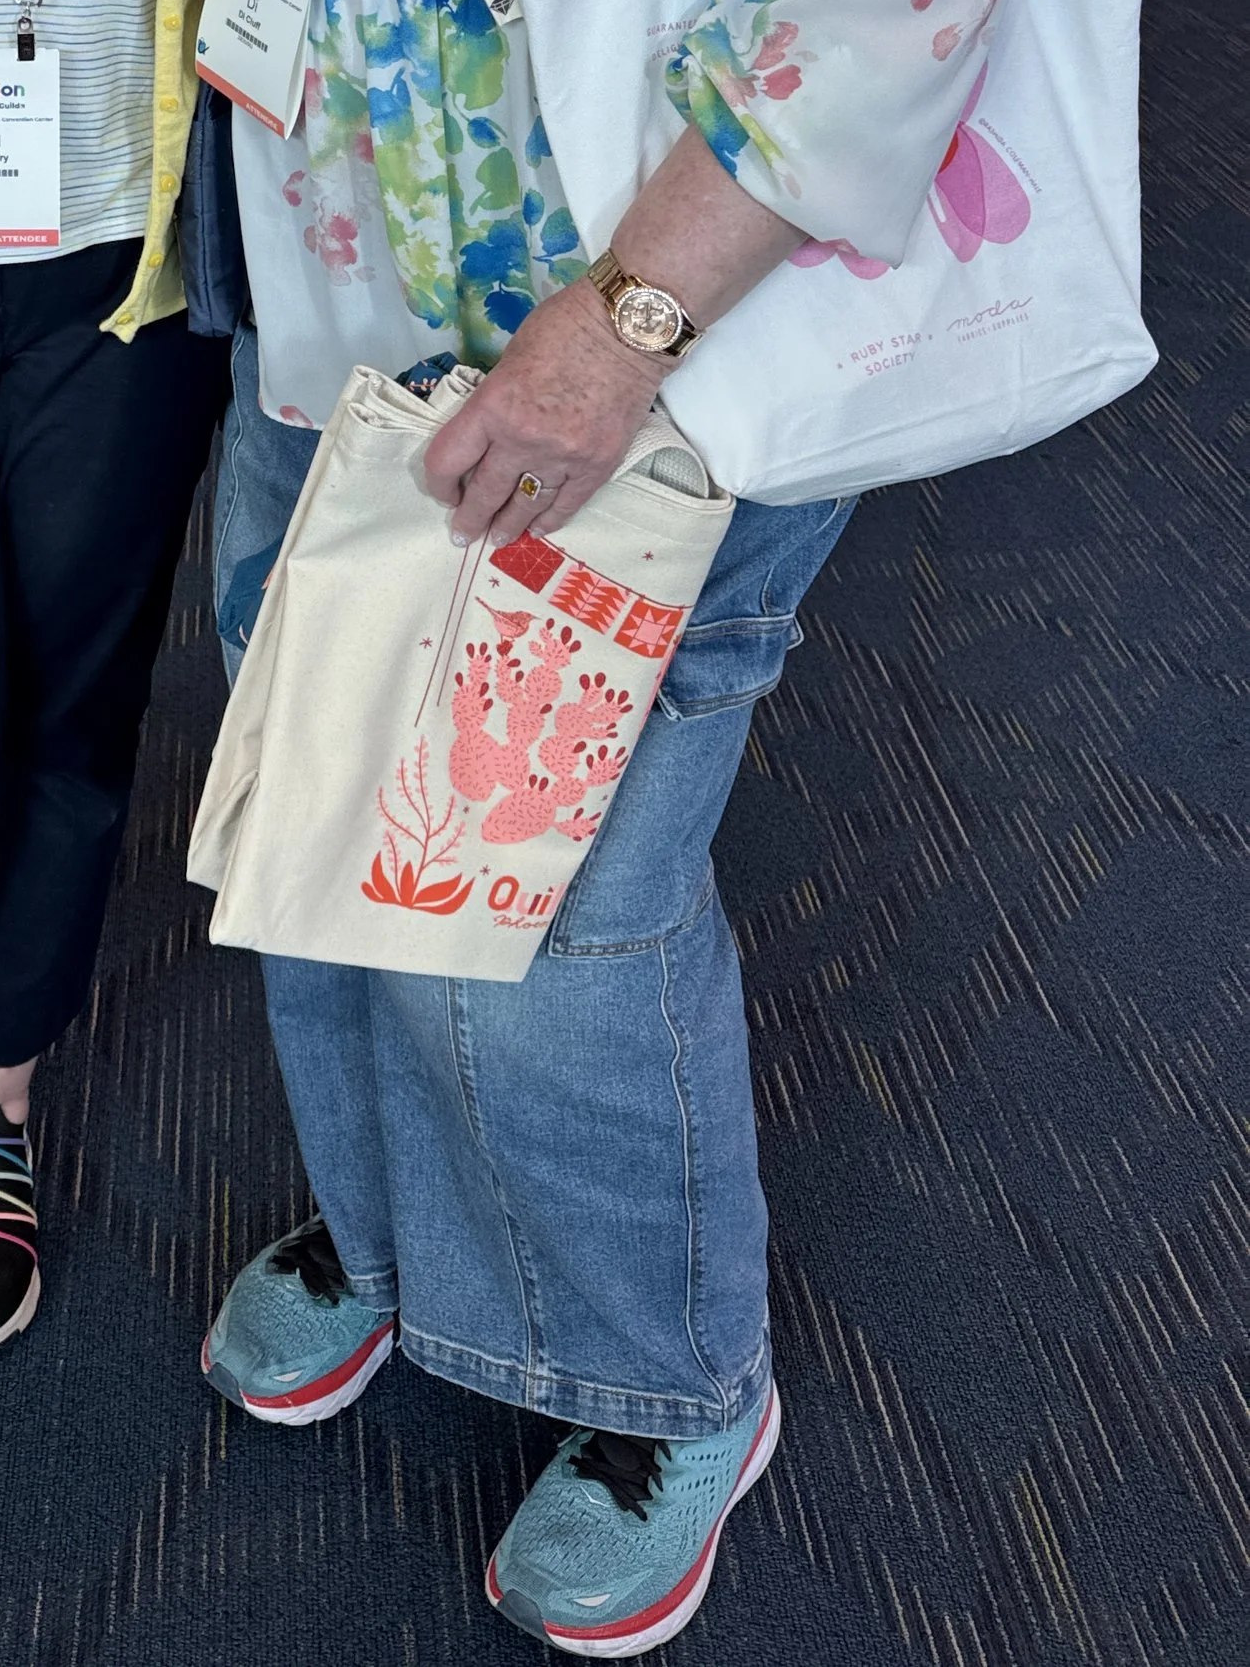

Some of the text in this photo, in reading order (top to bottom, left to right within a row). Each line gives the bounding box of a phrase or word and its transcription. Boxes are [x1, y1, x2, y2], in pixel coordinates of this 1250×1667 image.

[946, 296, 1033, 332] moda
[850, 333, 922, 363] RUBY STAR
[865, 352, 916, 376] SOCIETY
